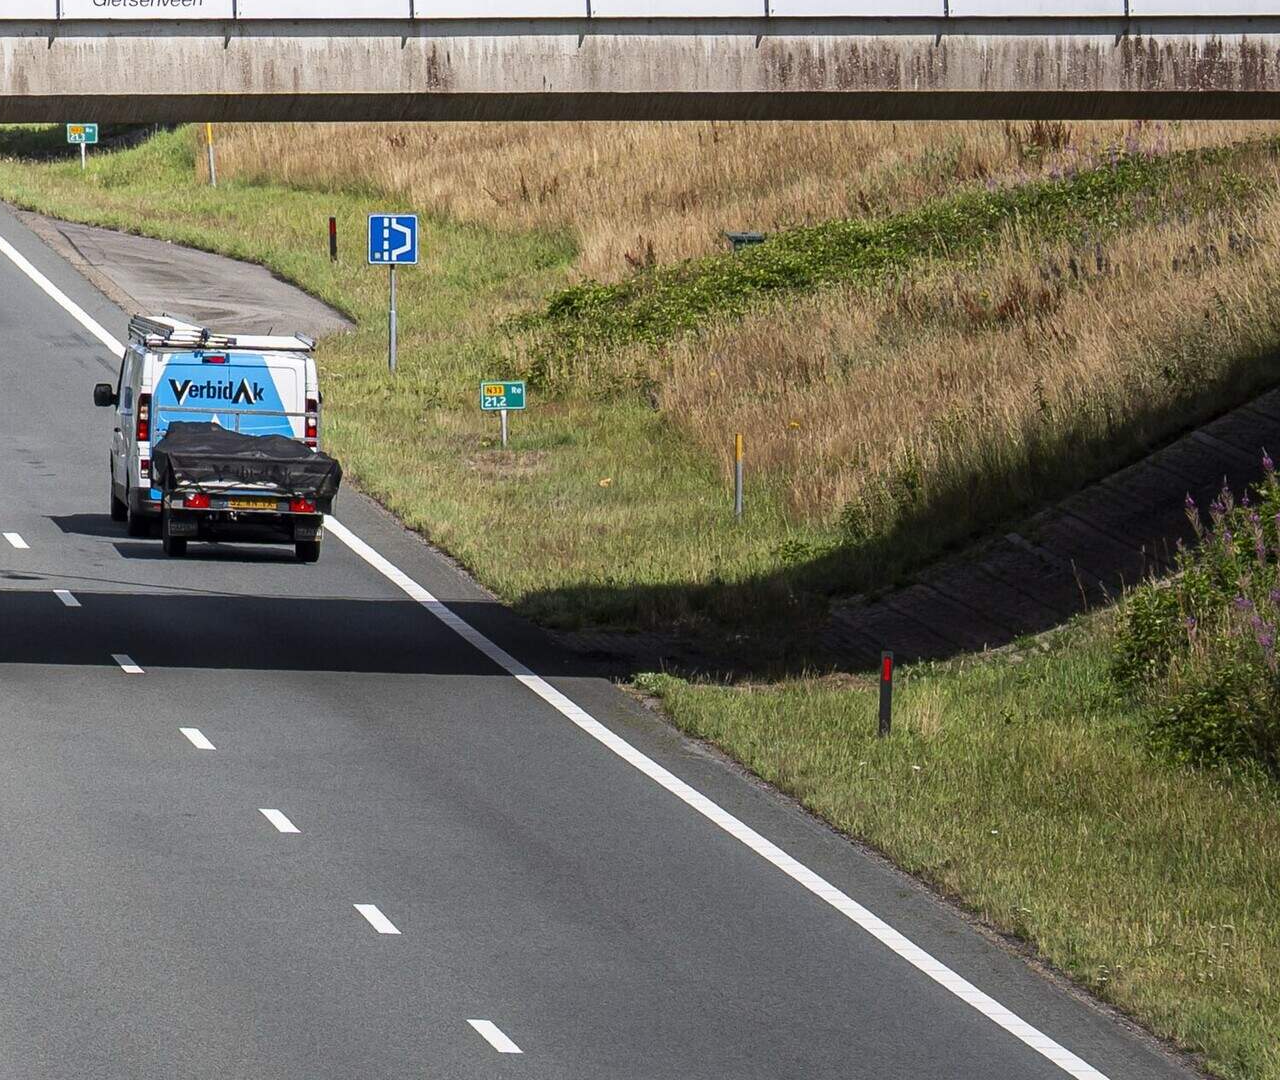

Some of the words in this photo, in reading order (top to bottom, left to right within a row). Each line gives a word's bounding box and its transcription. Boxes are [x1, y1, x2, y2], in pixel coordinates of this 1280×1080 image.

[168, 377, 265, 406] VerbidAk
[486, 386, 503, 394] N33
[511, 386, 522, 395] Re
[484, 396, 507, 407] 21.2
